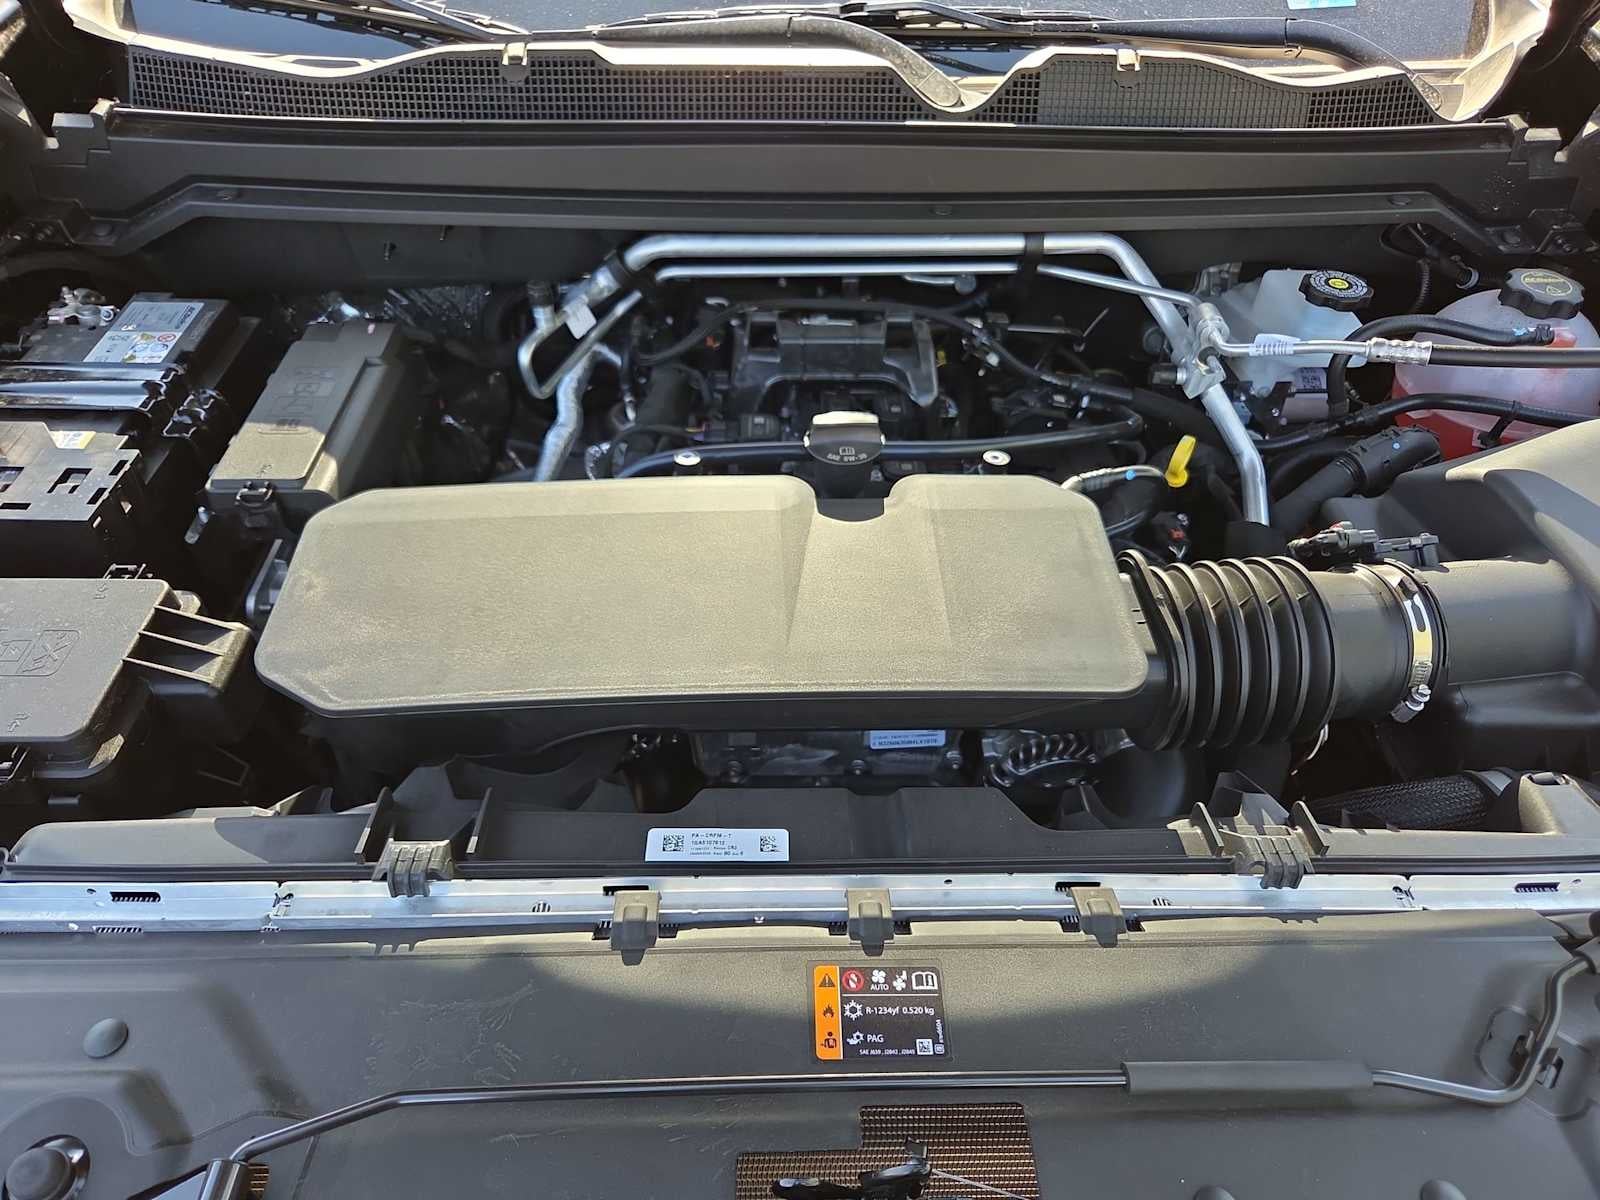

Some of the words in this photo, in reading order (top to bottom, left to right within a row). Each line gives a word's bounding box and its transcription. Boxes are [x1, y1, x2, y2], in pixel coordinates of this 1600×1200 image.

[865, 1006, 900, 1016] R-1234yf
[902, 1006, 924, 1014] 0.520
[924, 1006, 935, 1016] kg
[866, 1034, 884, 1043] PAG
